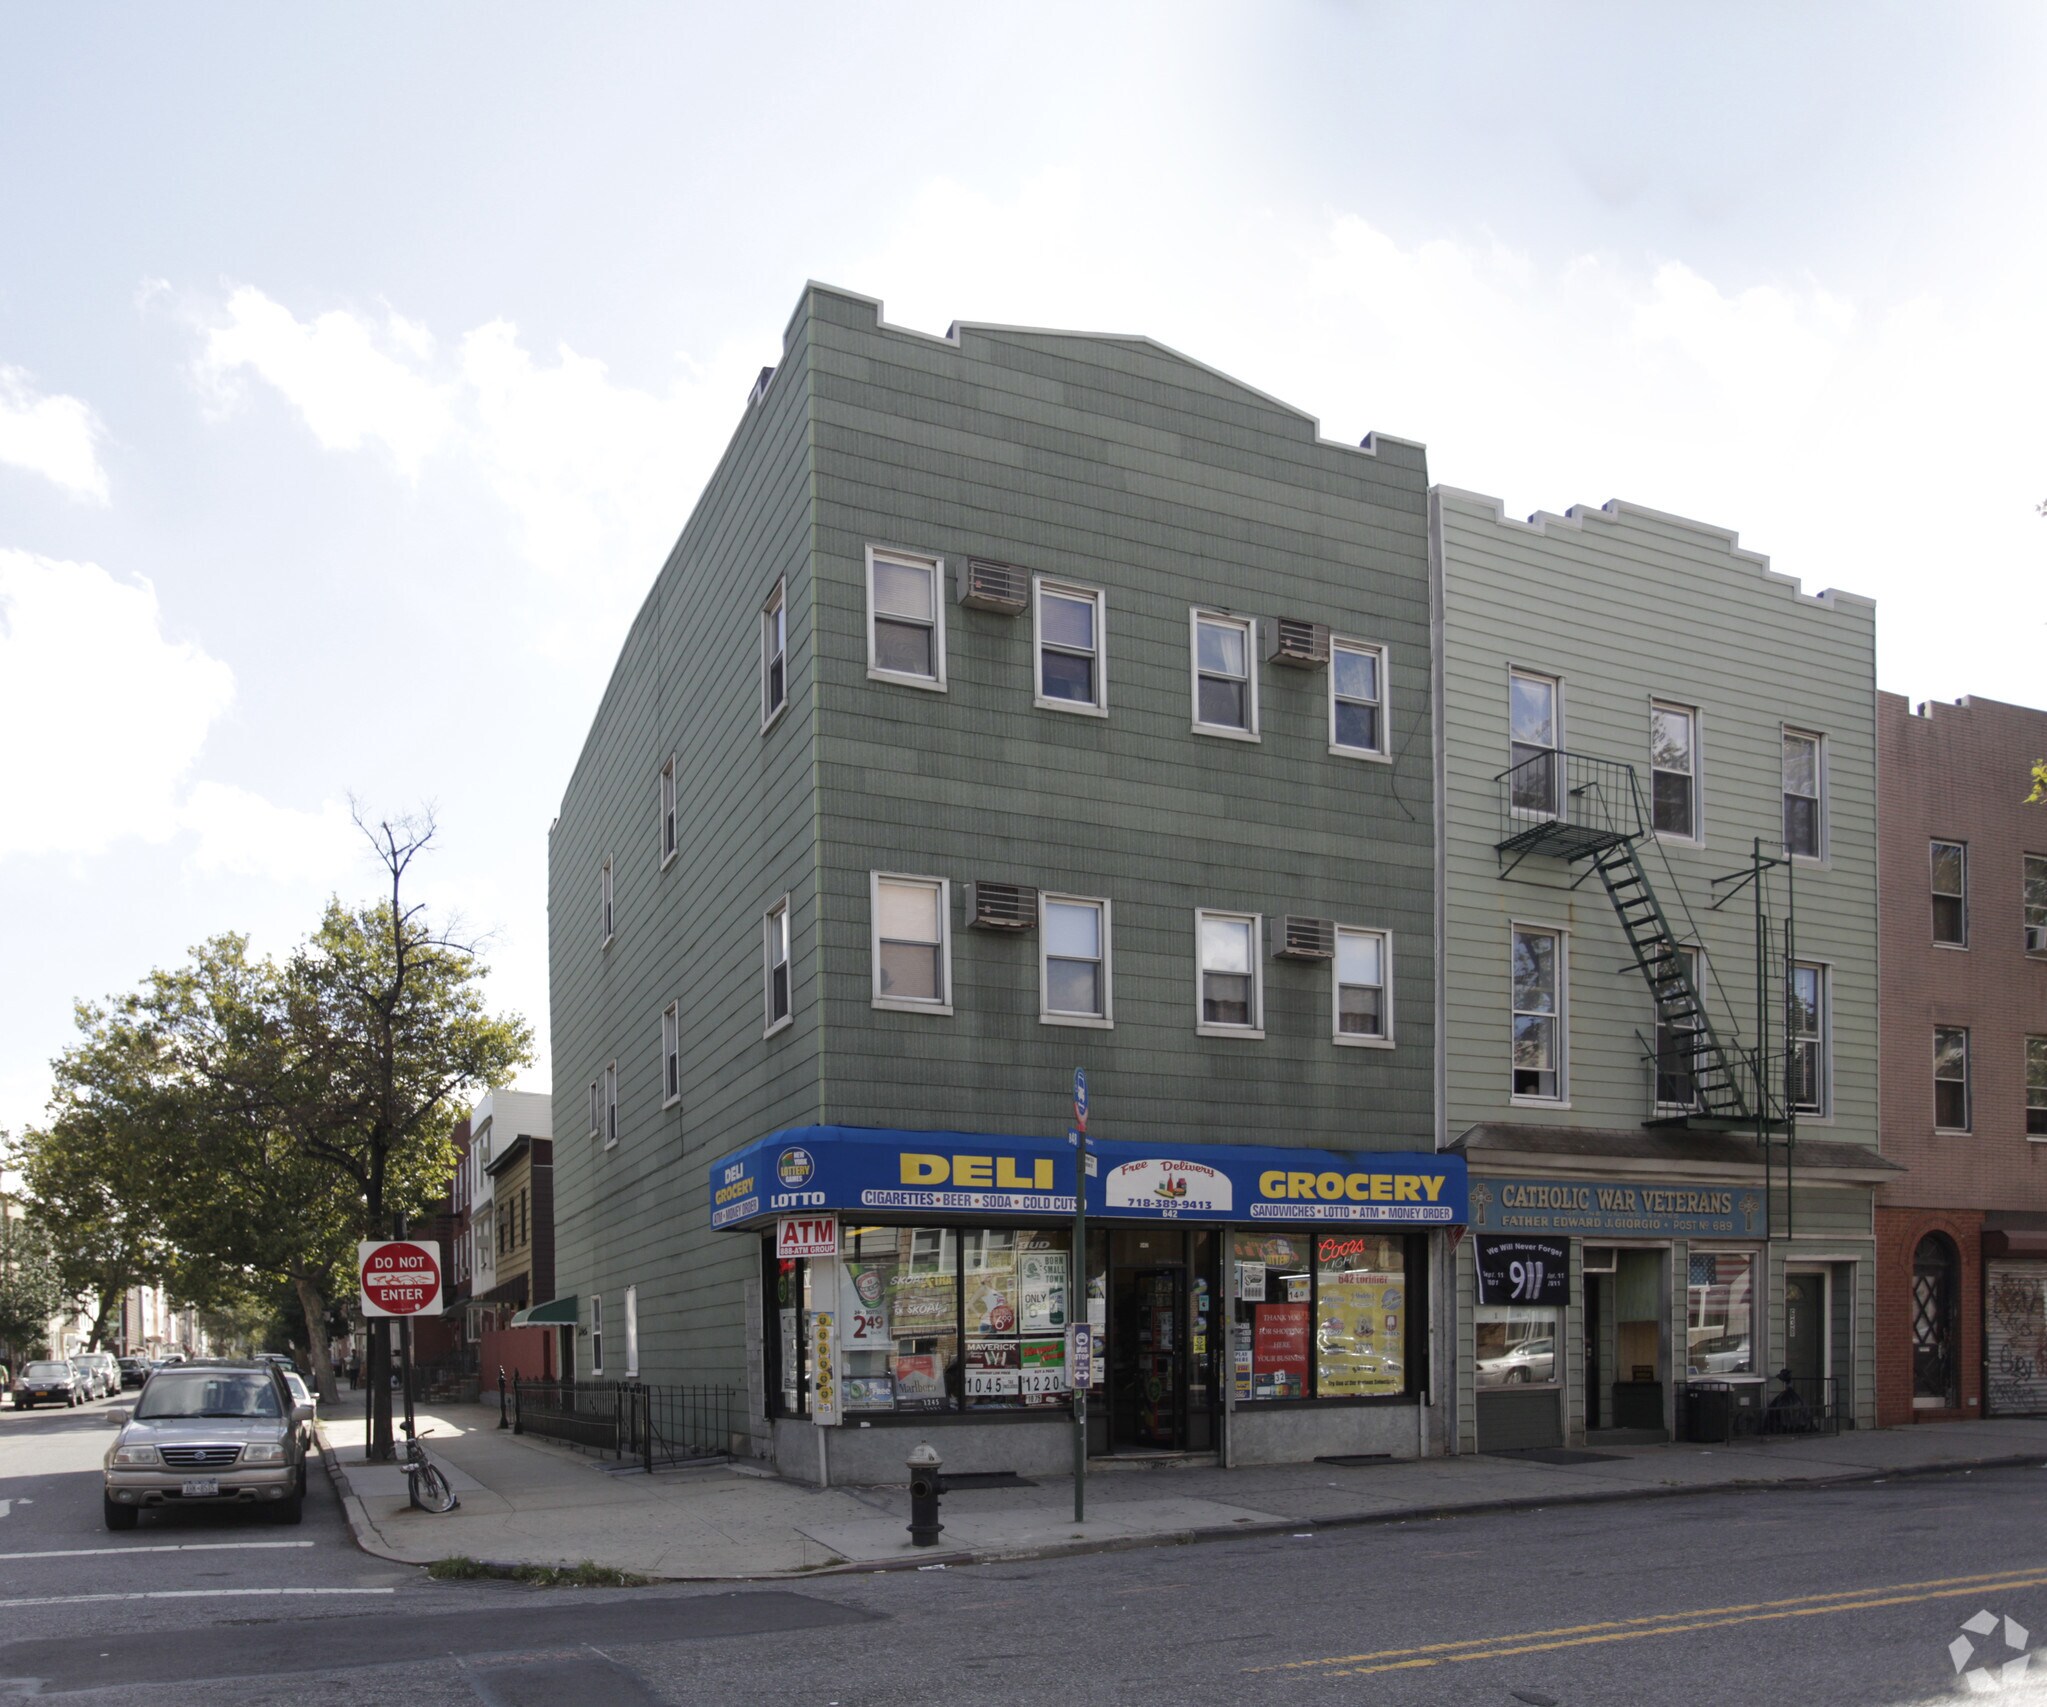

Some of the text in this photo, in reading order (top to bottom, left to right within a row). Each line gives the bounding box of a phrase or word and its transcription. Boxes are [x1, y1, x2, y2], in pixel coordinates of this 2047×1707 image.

[724, 1162, 744, 1185] DELI
[780, 1165, 810, 1176] LOTTERY
[900, 1152, 1053, 1190] DELI
[1120, 1160, 1215, 1178] Free Delivery
[715, 1176, 755, 1205] GROCERY
[1258, 1170, 1446, 1202] GROCERY
[770, 1192, 826, 1208] LOTTO
[864, 1190, 934, 1206] CIGARETTES
[943, 1194, 972, 1206] BEER
[982, 1194, 1012, 1208] SODA
[1023, 1196, 1050, 1210] COLD
[1128, 1198, 1212, 1210] 718-389-9413
[1502, 1184, 1732, 1214] CATHOLIC WAR VETERANS
[714, 1198, 757, 1224] ATM MONEY ORDER
[1162, 1210, 1178, 1218] 642
[1252, 1204, 1450, 1219] SANDWICHES LOTTO ATM MONEY ORDER
[1502, 1216, 1549, 1227] FATHER
[1552, 1217, 1600, 1228] EDWARD
[1673, 1220, 1696, 1230] POST
[1712, 1220, 1732, 1231] 689
[782, 1220, 833, 1244] ATM
[780, 1244, 834, 1256] 888-ATM GROUP
[1318, 1238, 1365, 1262] Coors
[1486, 1247, 1498, 1256] We
[1500, 1244, 1514, 1252] Will
[1538, 1244, 1562, 1258] Forget
[374, 1256, 424, 1269] DO NOT
[1045, 1256, 1064, 1265] BORN
[1044, 1266, 1066, 1274] SMALL
[1046, 1274, 1064, 1283] TOWN
[380, 1288, 424, 1300] ENTER
[1025, 1294, 1046, 1304] ONLY
[908, 1302, 941, 1314] SKOAL
[1276, 1372, 1284, 1381] 32
[900, 1380, 936, 1393] Marlboro
